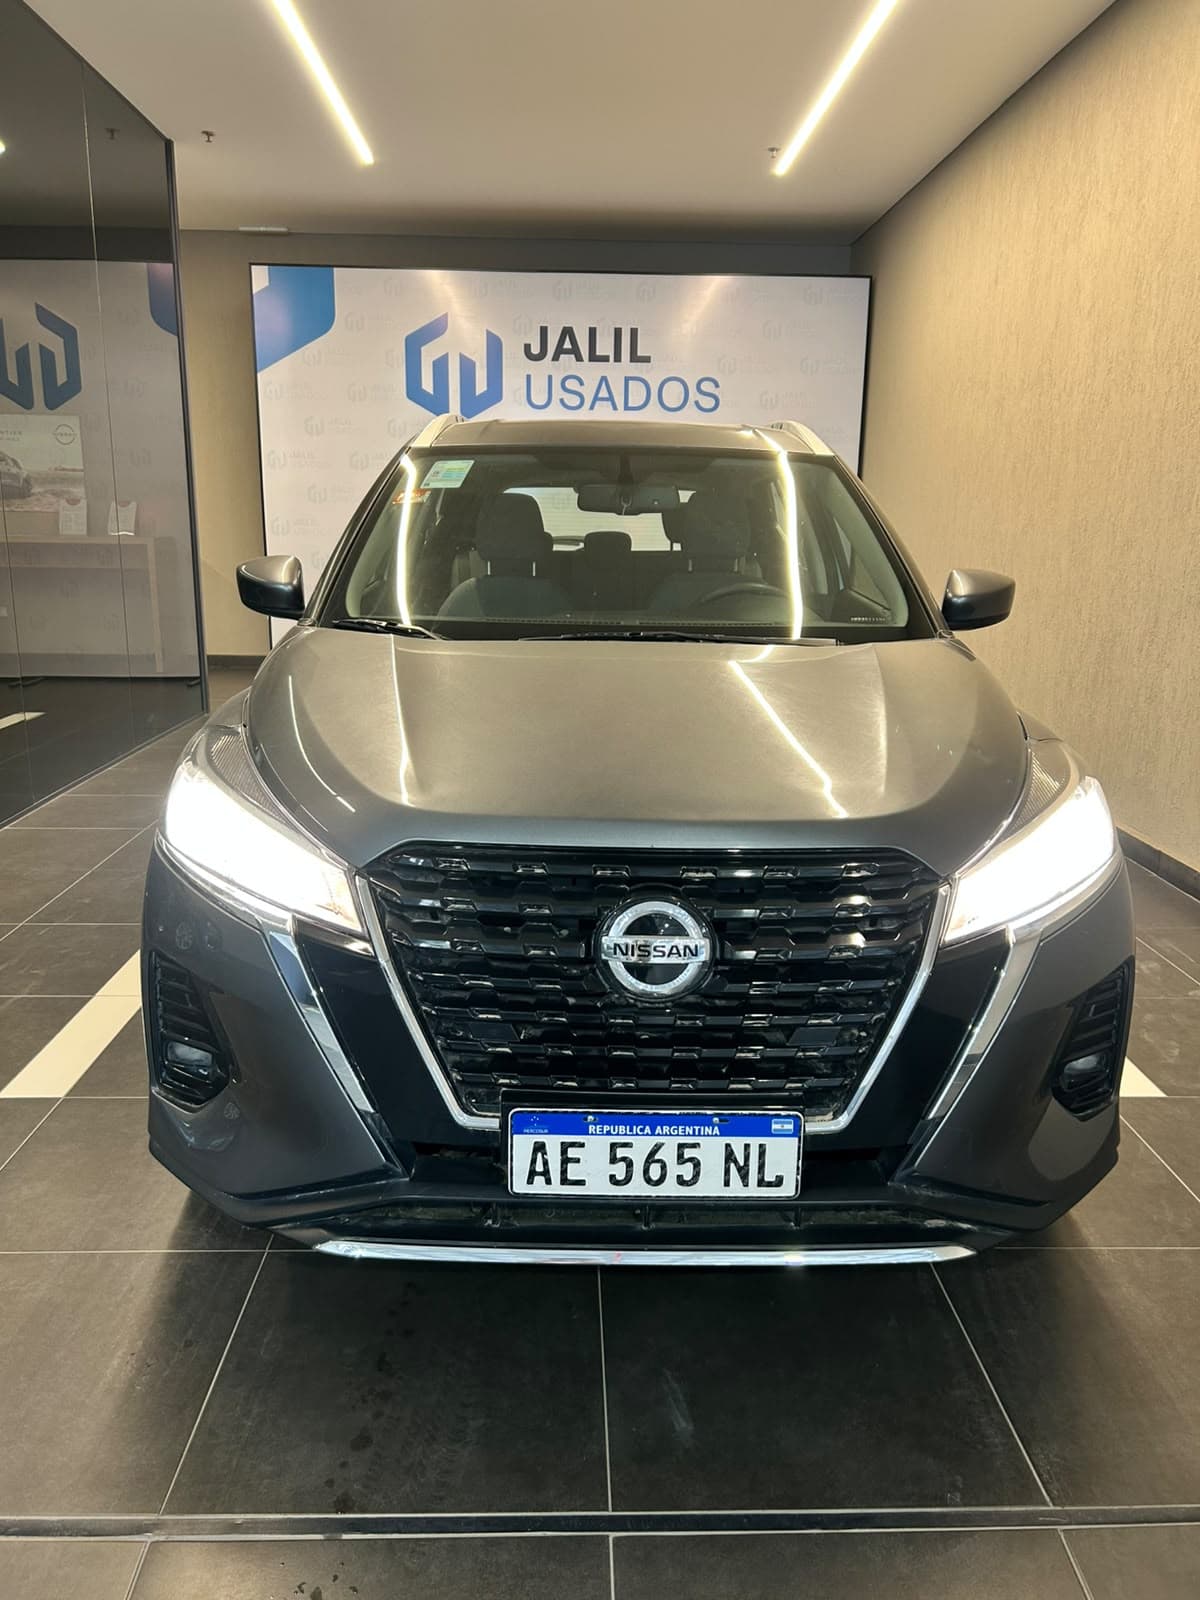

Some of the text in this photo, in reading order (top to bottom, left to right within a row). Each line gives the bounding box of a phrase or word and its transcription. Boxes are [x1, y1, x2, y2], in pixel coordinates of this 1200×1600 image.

[524, 326, 652, 363] JALIL
[525, 374, 720, 413] USADOS
[613, 943, 698, 958] NISSAN
[588, 1125, 720, 1136] REPUBLICA ARGENTINA
[526, 1141, 784, 1188] AE 565 NL
